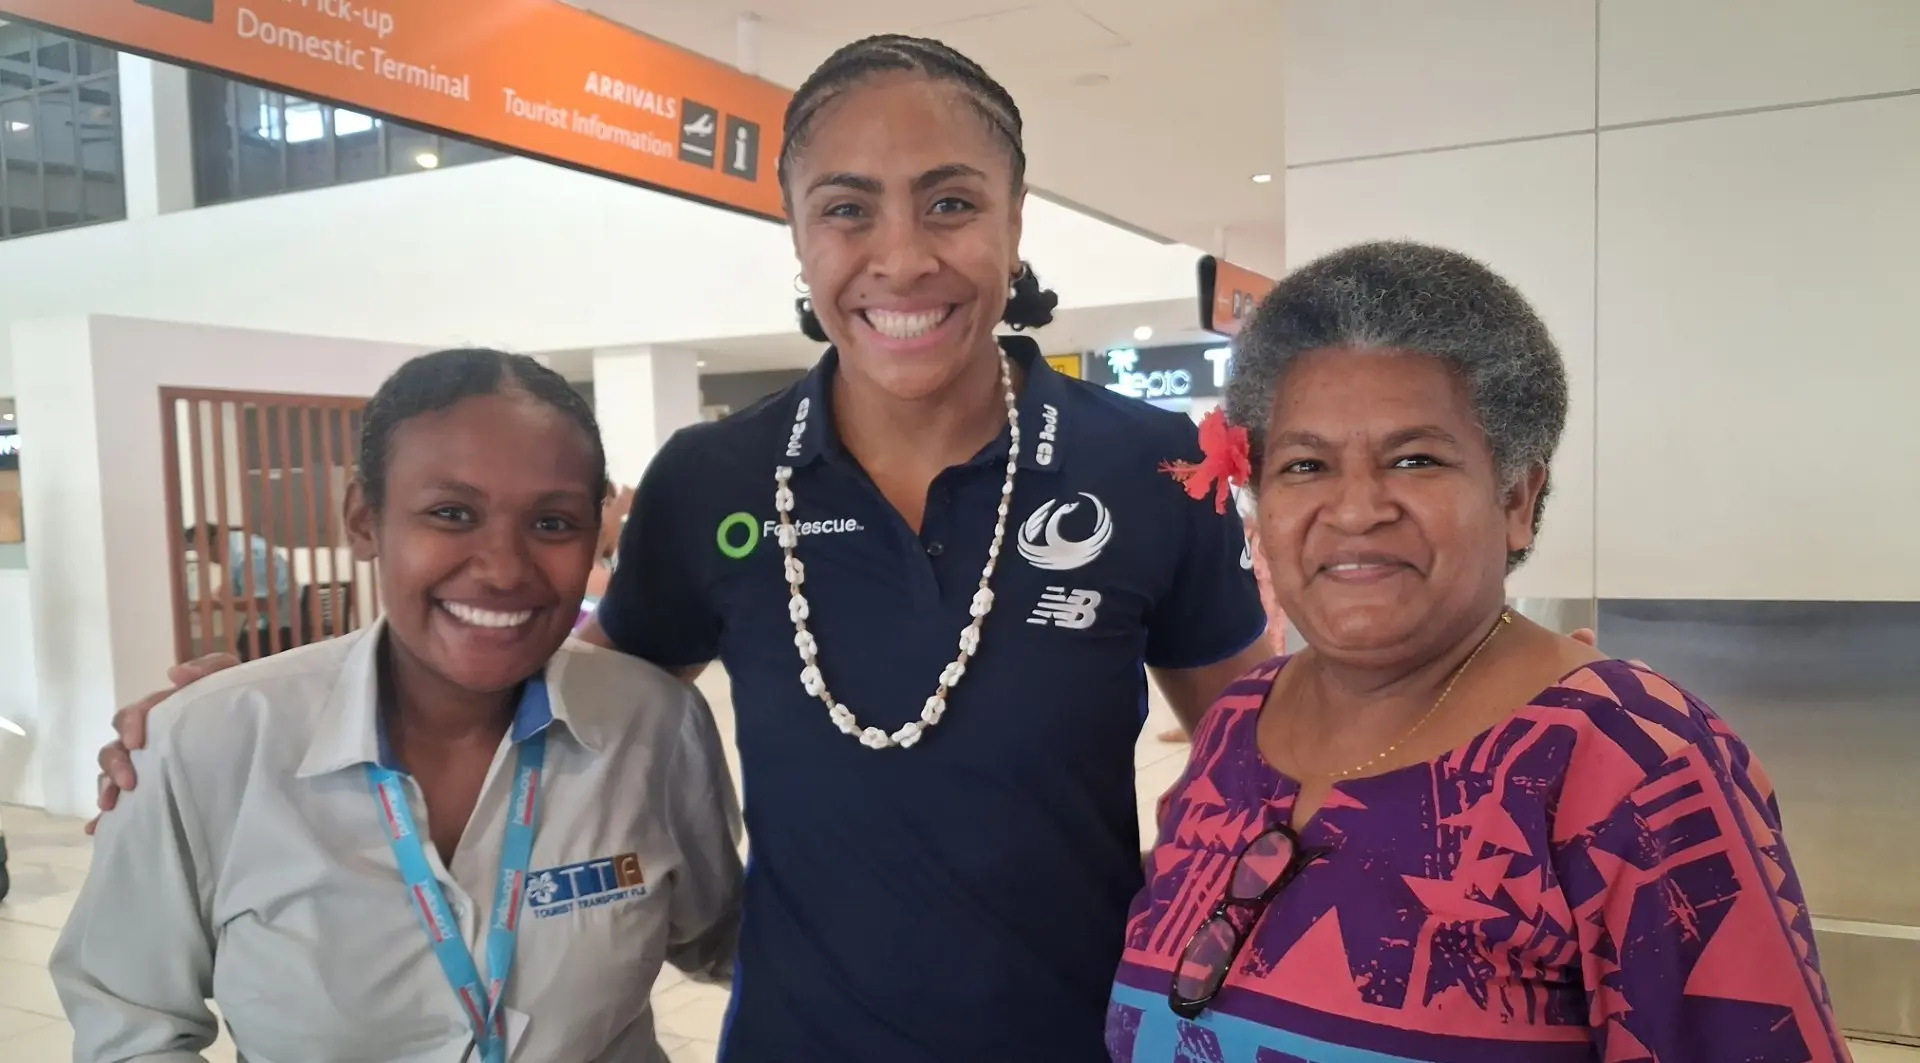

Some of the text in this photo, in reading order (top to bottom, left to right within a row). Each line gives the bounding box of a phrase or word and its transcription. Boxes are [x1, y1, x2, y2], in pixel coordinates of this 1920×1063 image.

[302, 0, 394, 39] ck-up
[236, 8, 470, 101] Domestic Terminal
[584, 71, 677, 119] ARRIVALS
[503, 87, 674, 159] Tourist Information
[763, 518, 857, 538] Ftescue
